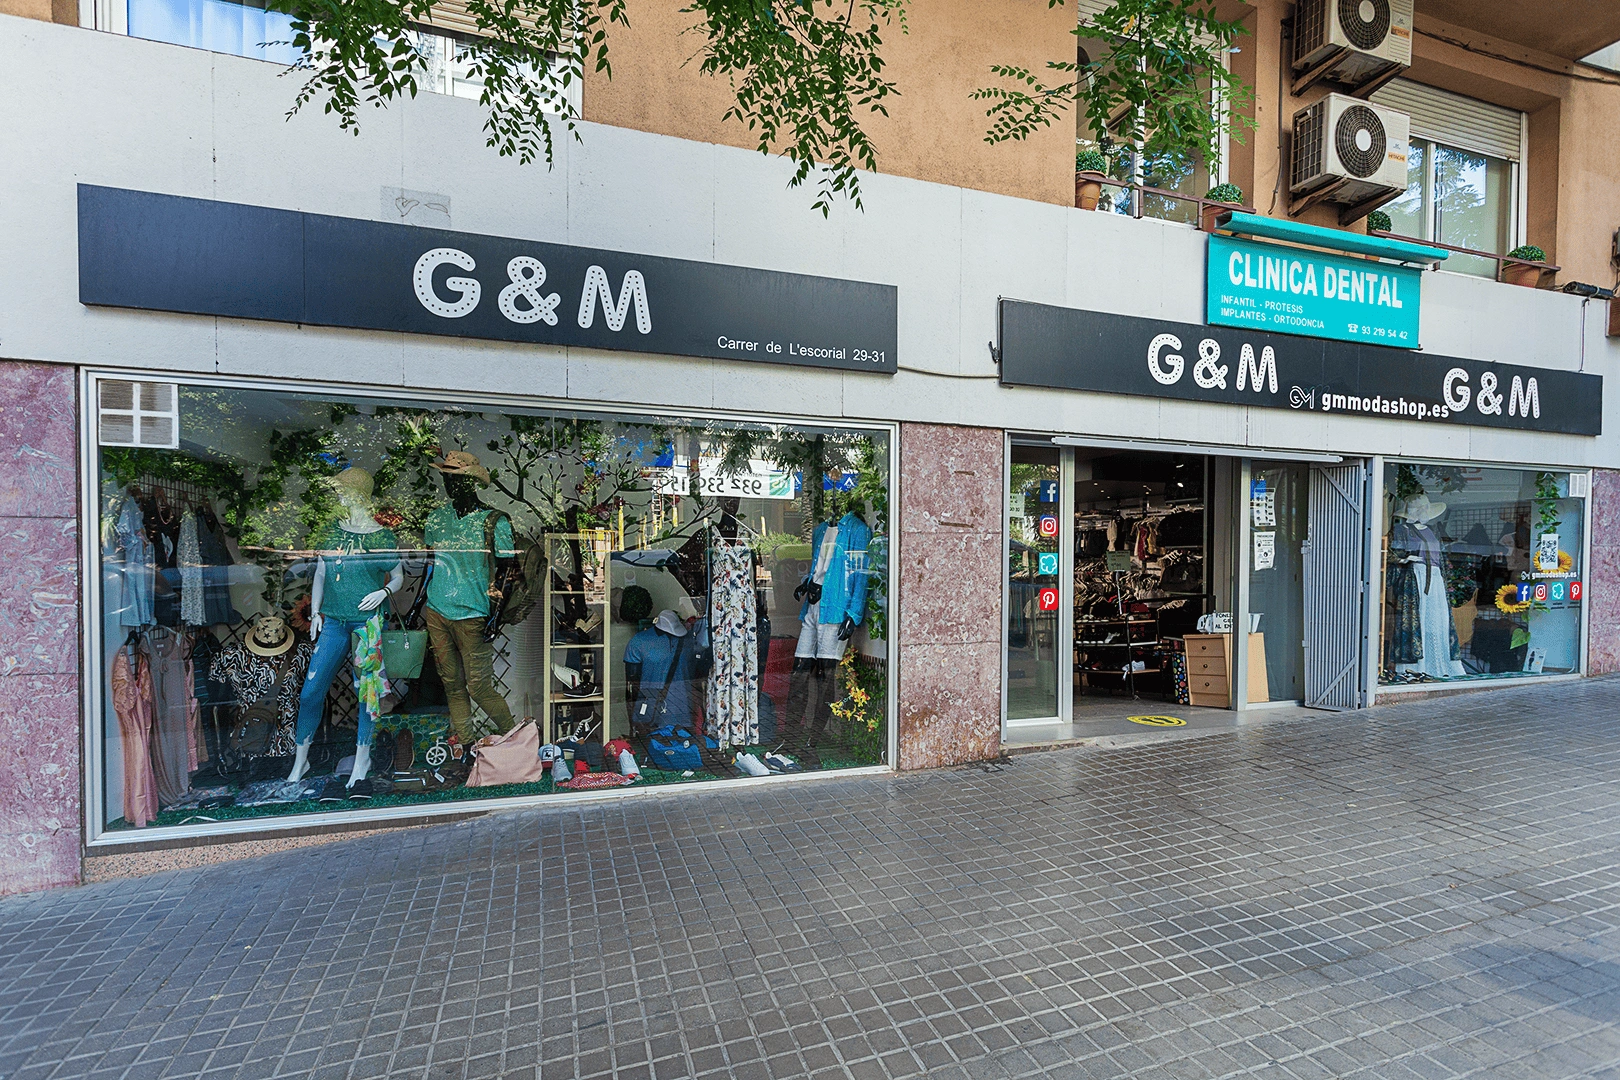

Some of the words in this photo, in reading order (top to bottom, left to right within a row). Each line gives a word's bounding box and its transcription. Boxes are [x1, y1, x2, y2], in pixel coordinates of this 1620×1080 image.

[1228, 251, 1318, 296] CLINICA
[1324, 266, 1403, 308] DENTAL
[1221, 294, 1257, 308] INFANTIL
[1264, 300, 1304, 314] PROTESIS
[1221, 307, 1266, 322] IMPLANTES
[1274, 314, 1325, 329] ORTODONCIA
[1361, 325, 1371, 335] 93
[1373, 327, 1386, 337] 219
[1387, 329, 1397, 338] 54
[1399, 330, 1408, 340] 42
[717, 336, 759, 352] Carrer
[766, 341, 782, 354] de
[789, 342, 846, 360] L'escorial
[853, 349, 886, 363] 29-31
[1322, 391, 1449, 419] gmmodashop.es
